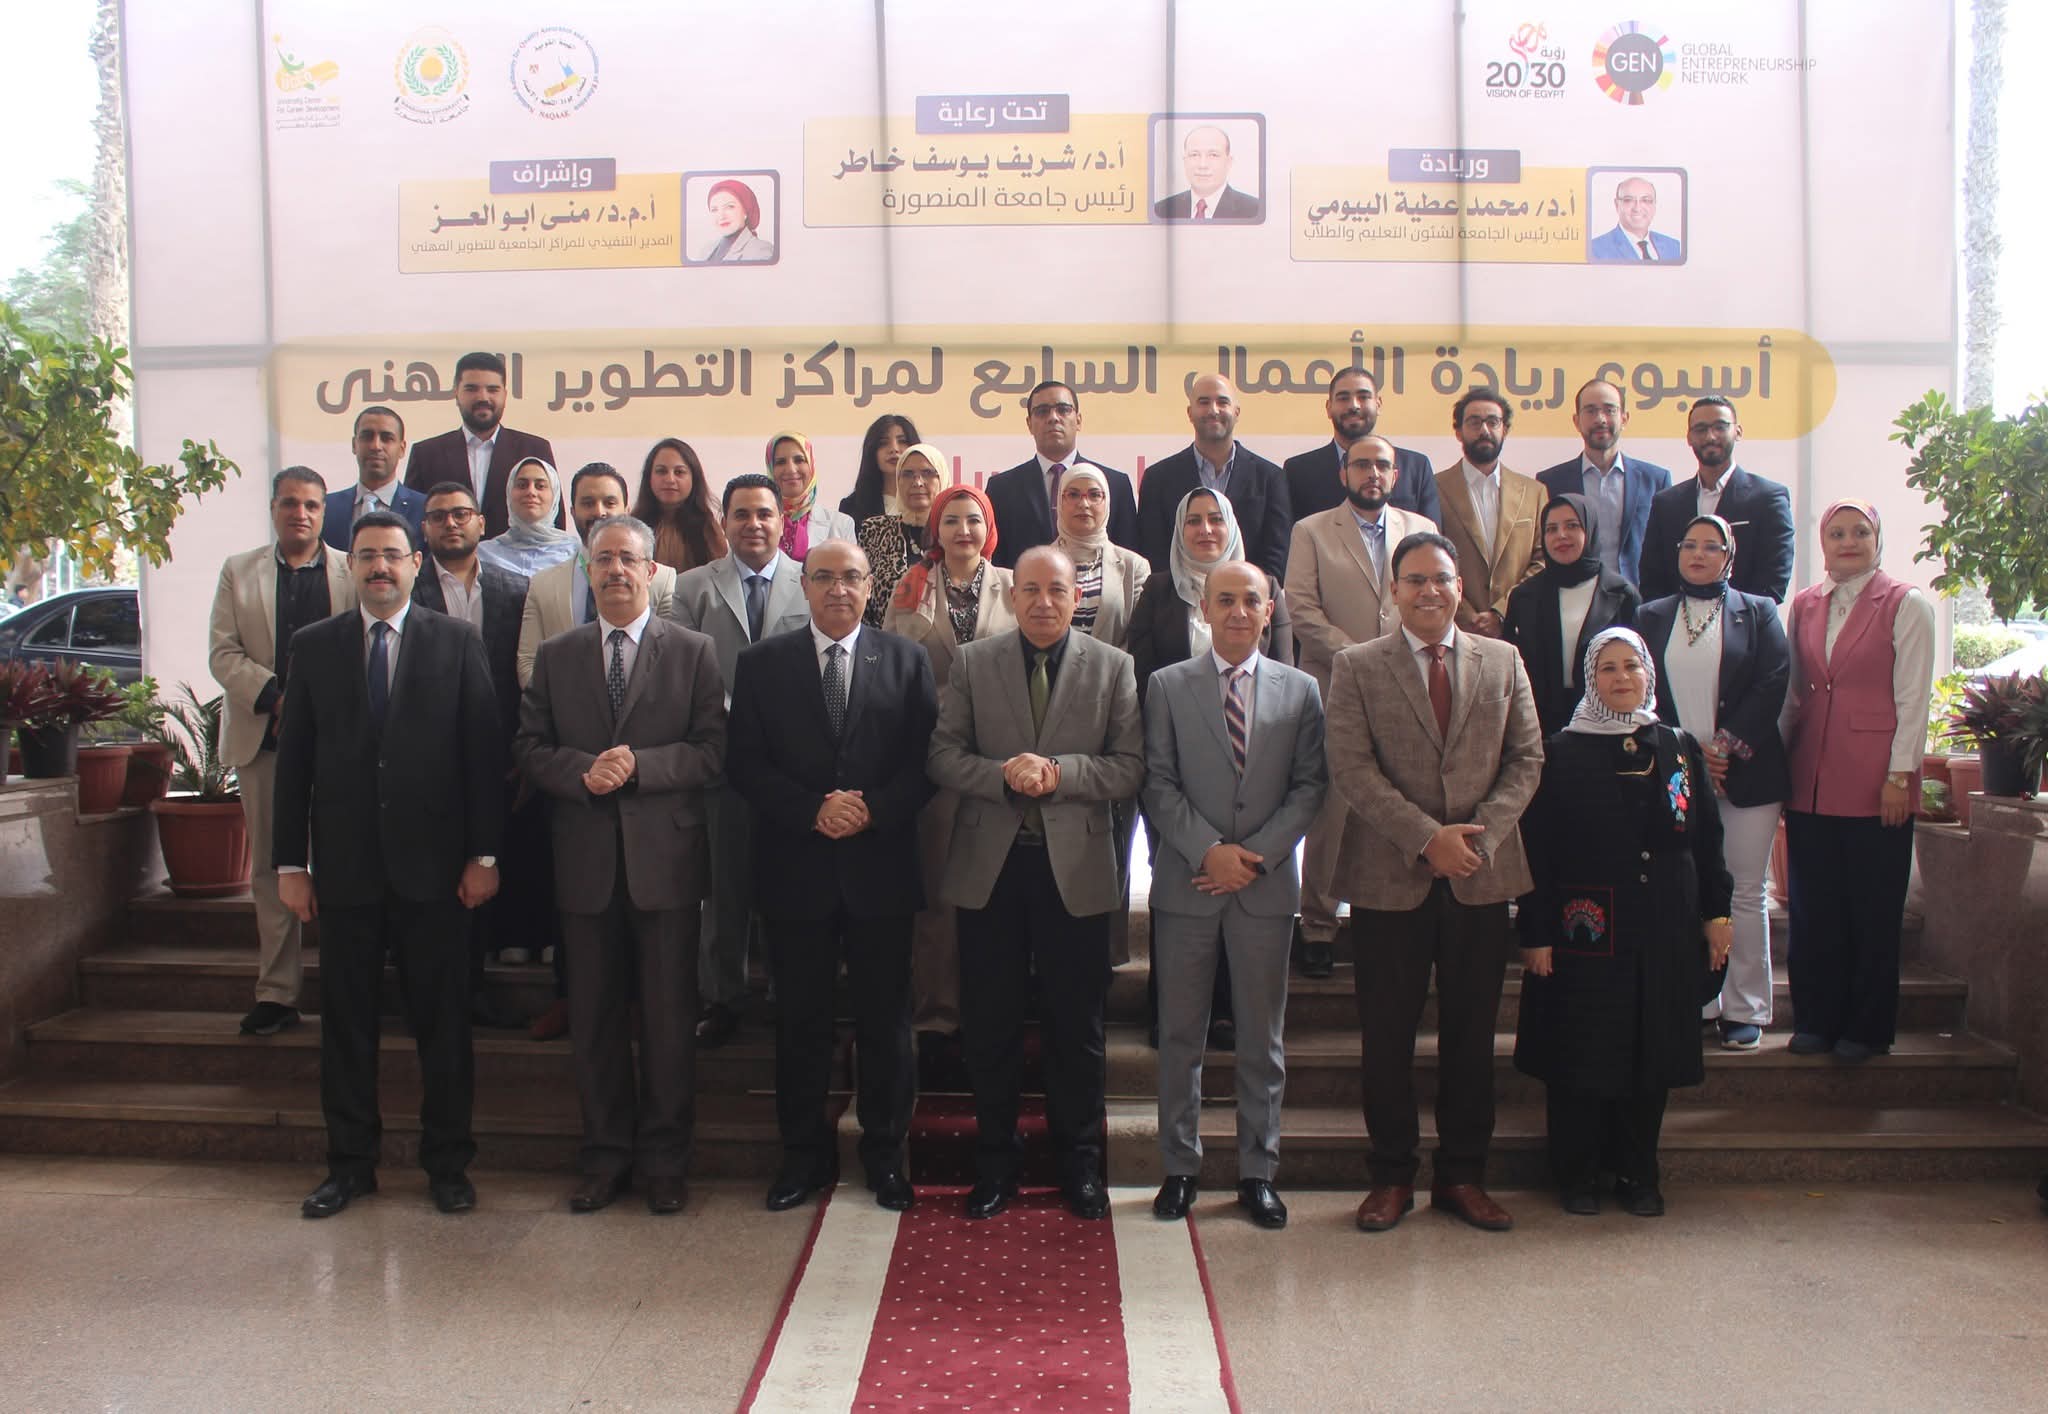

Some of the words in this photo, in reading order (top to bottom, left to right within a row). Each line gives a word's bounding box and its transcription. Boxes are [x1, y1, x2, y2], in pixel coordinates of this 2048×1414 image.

[1681, 43, 1734, 57] GLOBAL
[1485, 61, 1566, 89] 2030
[1610, 52, 1657, 74] GEN
[1681, 58, 1817, 71] ENTREPRENEURSHIP
[1681, 71, 1749, 85] NETWORK
[1485, 89, 1517, 98] VISION
[1518, 89, 1532, 98] OF
[1534, 89, 1565, 99] EGYPT
[938, 101, 995, 128] رعاية
[1002, 100, 1048, 122] تحت
[832, 147, 905, 180] خاطر
[912, 146, 990, 178] يوسف
[996, 143, 1076, 178] شريف
[1419, 153, 1489, 179] وريادة
[512, 162, 592, 188] وإشراف
[882, 187, 986, 215] المنصورة
[994, 187, 1067, 212] جامعة
[1075, 184, 1135, 213] رئيس
[1307, 192, 1388, 225] البيومي
[1394, 190, 1459, 223] عطية
[1466, 192, 1529, 217] محمد
[540, 200, 590, 231] منى
[499, 237, 546, 252] الجامعية
[548, 236, 585, 252] للمراكز
[588, 235, 637, 250] التنفيذي
[639, 234, 673, 250] المدير
[1304, 225, 1354, 242] والطلاب
[1360, 225, 1407, 243] التعليم
[1410, 225, 1454, 242] لشئون
[1458, 226, 1510, 242] الجامعة
[1514, 226, 1549, 244] رئيس
[1552, 226, 1579, 241] نائب
[455, 239, 496, 255] للتطوير
[316, 352, 523, 414] اهنى
[547, 348, 752, 411] التطوير
[776, 340, 943, 408] لمراكز
[970, 345, 1157, 419] السابع
[1431, 345, 1565, 410] ريادة
